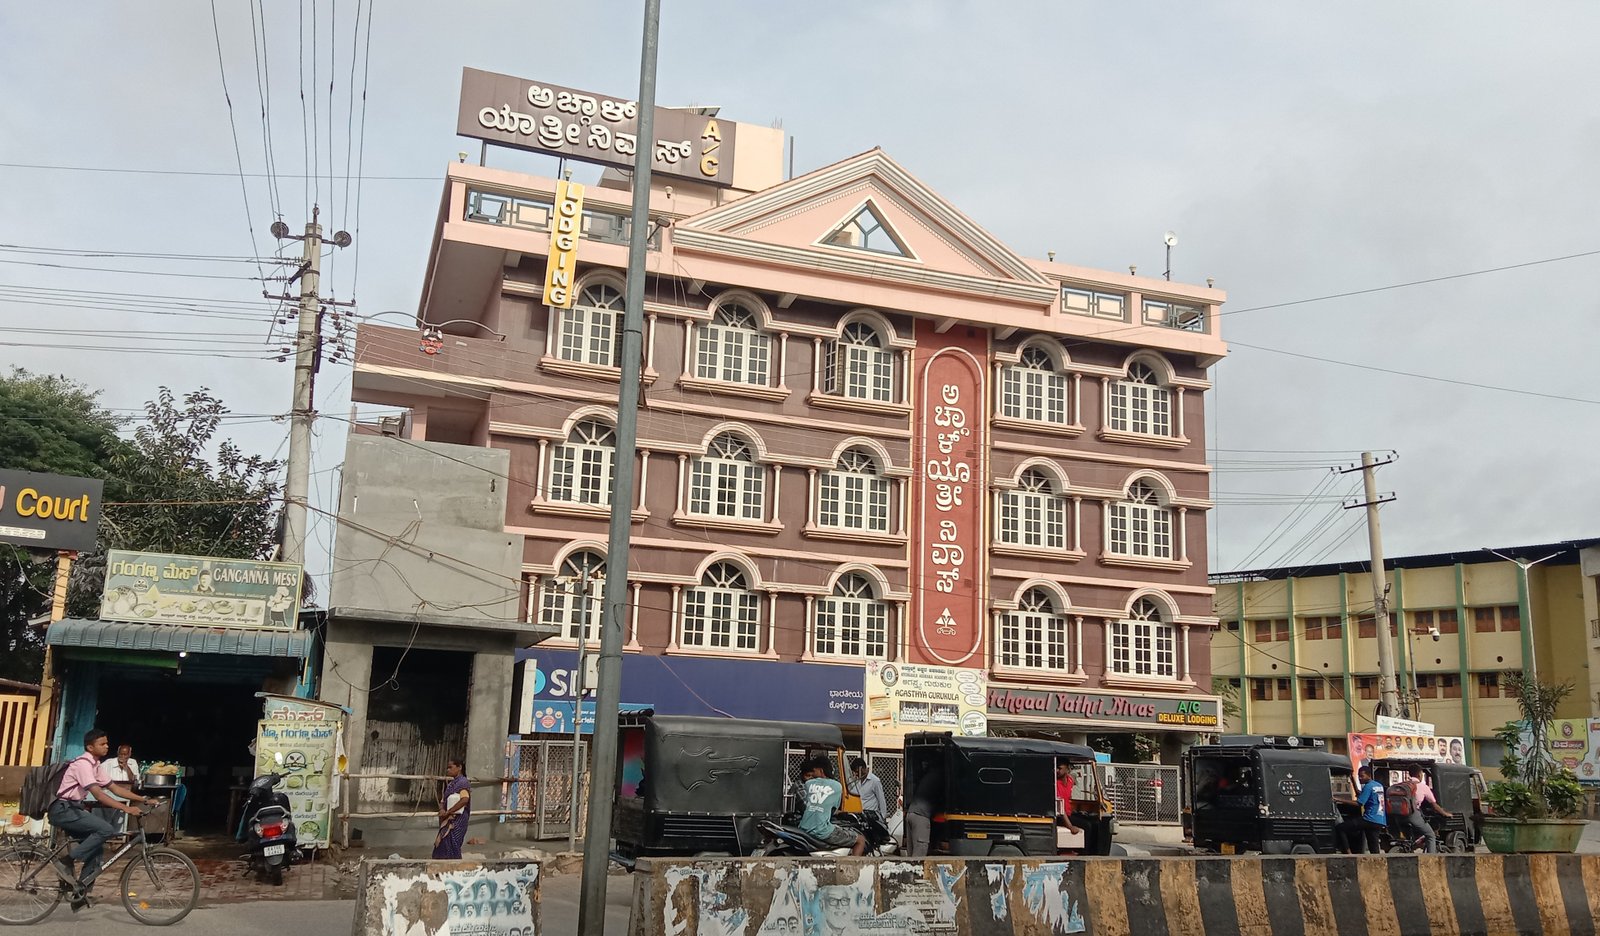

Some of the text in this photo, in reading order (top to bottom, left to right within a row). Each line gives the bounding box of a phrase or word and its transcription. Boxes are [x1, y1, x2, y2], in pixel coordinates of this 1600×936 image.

[700, 120, 721, 174] A/C
[549, 184, 579, 305] LODGING
[16, 488, 90, 522] Court
[273, 572, 297, 587] MESS
[894, 689, 928, 700] AGASTHYA
[928, 691, 960, 701] GURUKULA
[987, 690, 1155, 718] tchgaal Yathri Nivas
[1178, 700, 1201, 714] A/C
[1158, 713, 1218, 726] DELUXE LODGING
